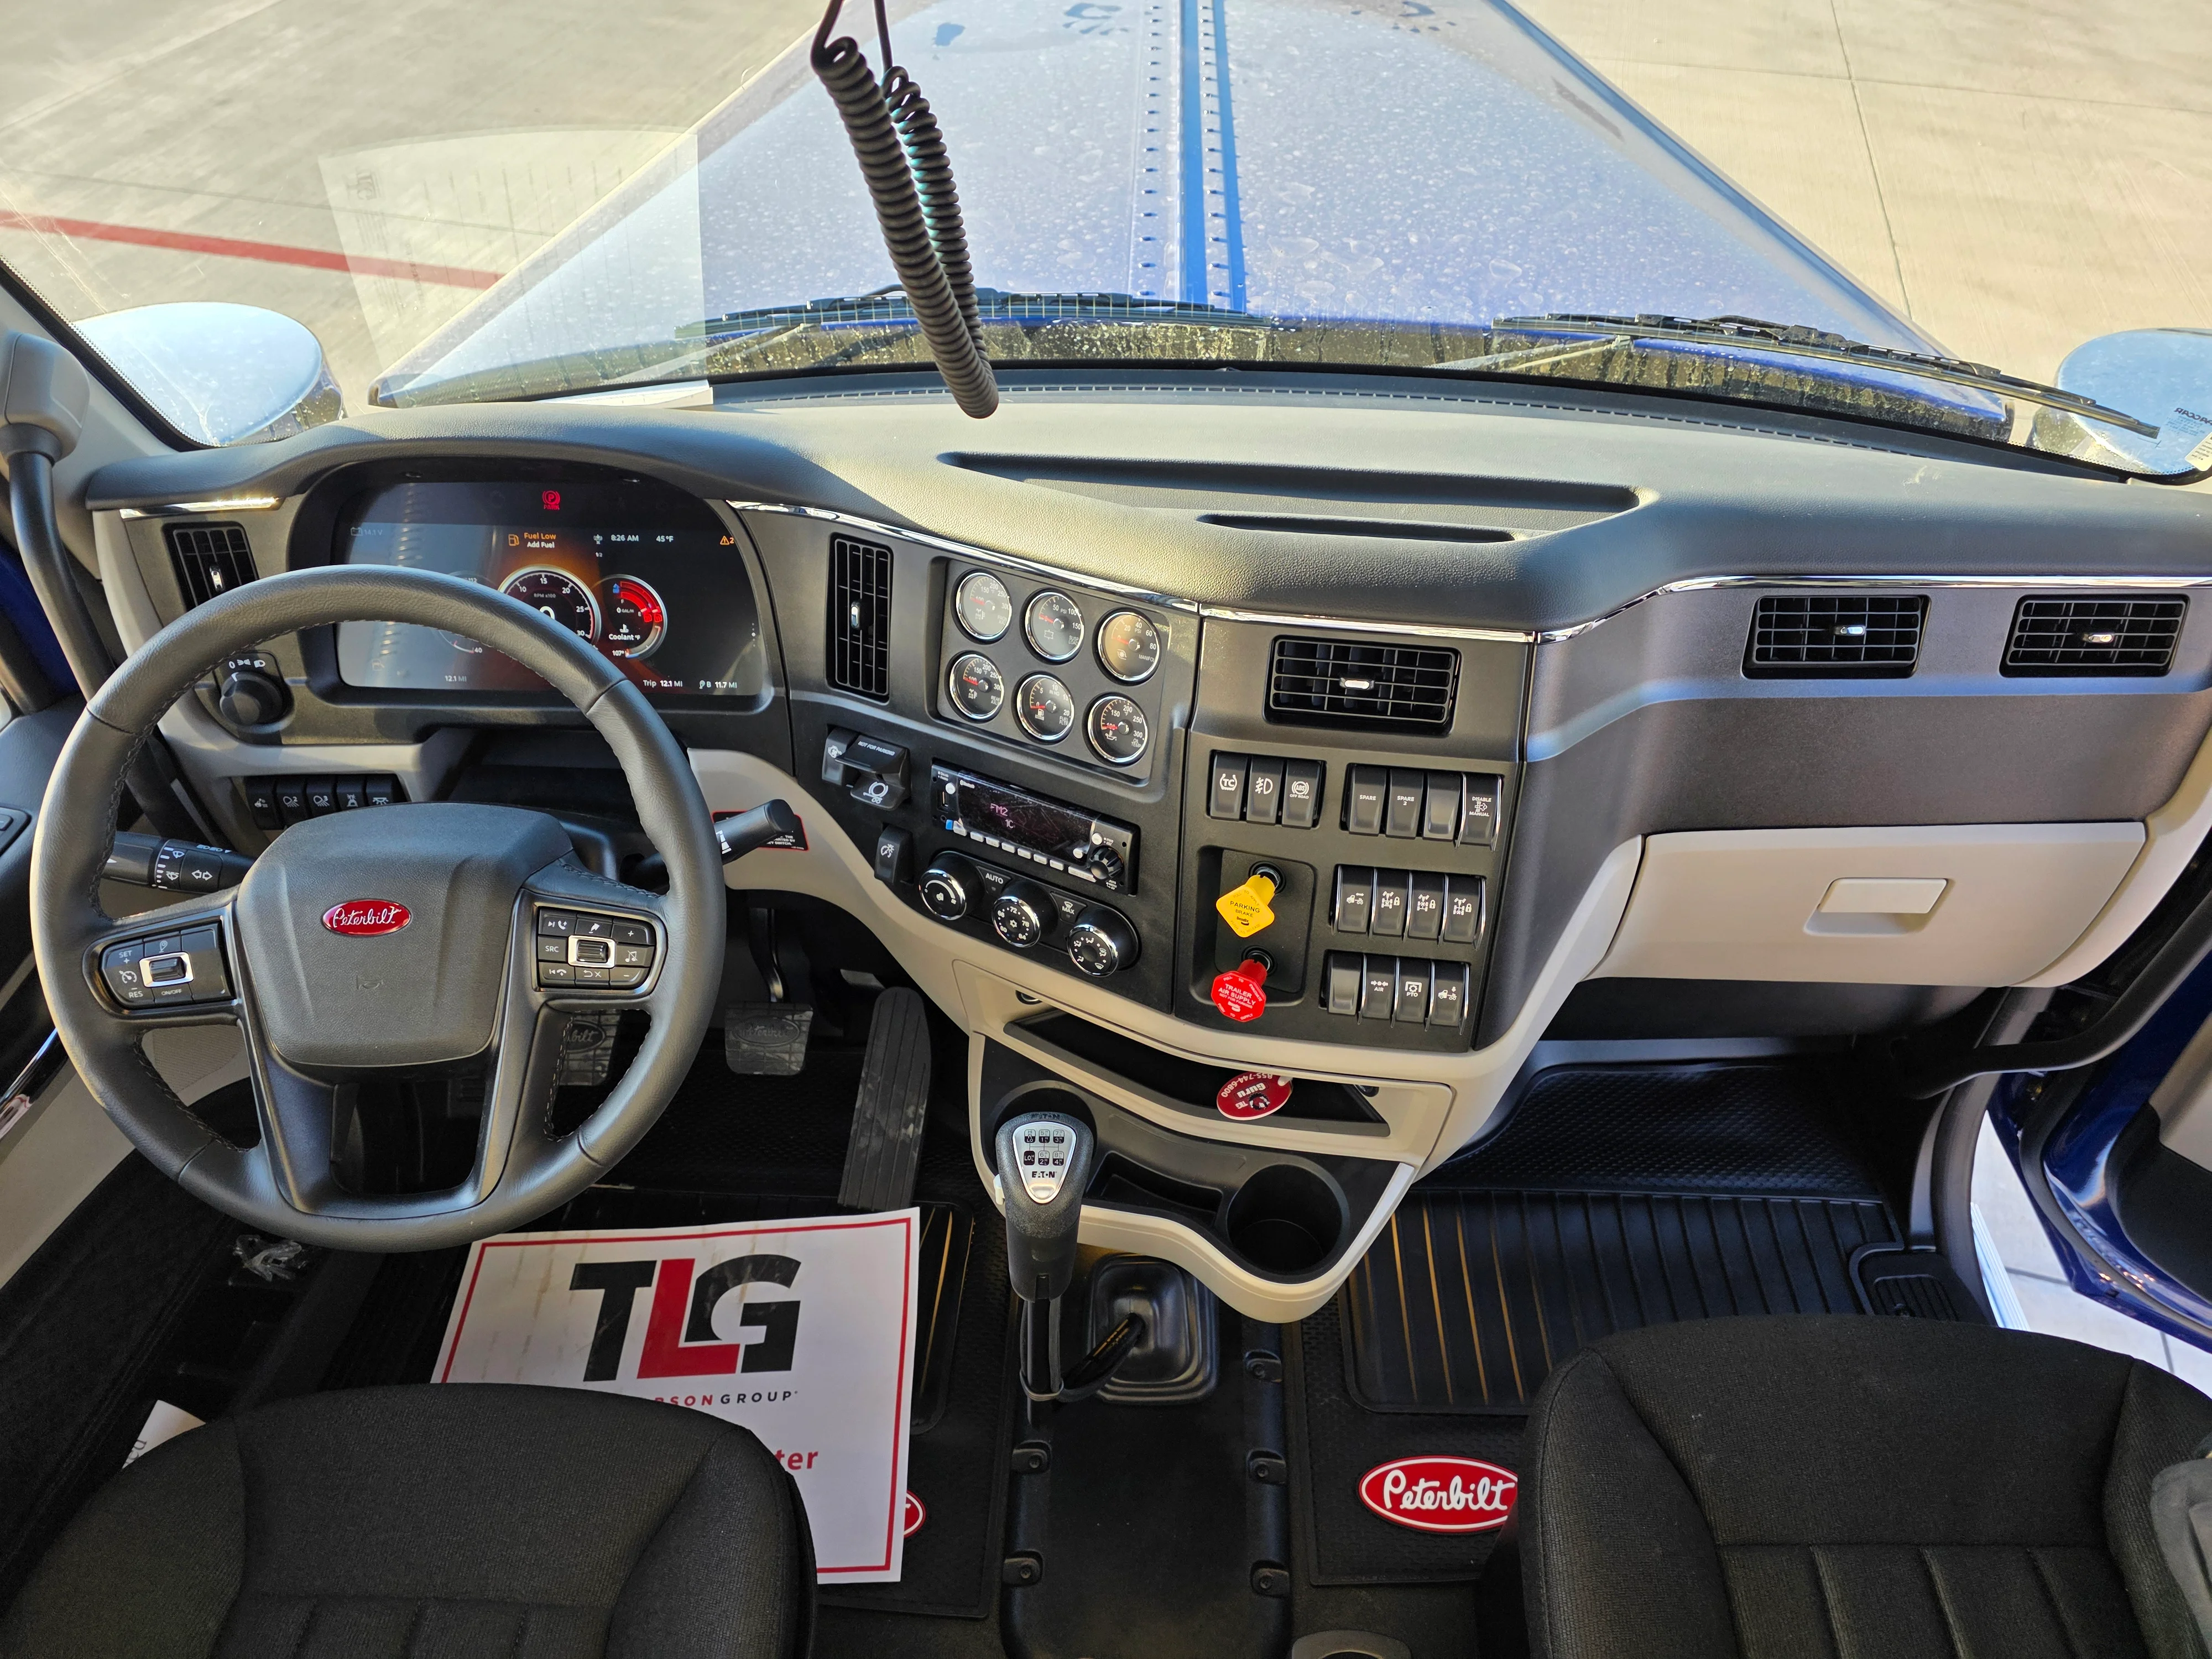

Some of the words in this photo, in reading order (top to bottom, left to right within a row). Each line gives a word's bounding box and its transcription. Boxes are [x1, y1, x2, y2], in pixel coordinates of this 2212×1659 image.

[643, 680, 657, 688] Trip
[1123, 705, 1133, 713] 200
[1133, 730, 1143, 738] 300
[875, 746, 895, 756] PARKING
[1223, 778, 1235, 787] TC
[985, 873, 1004, 884] AUTO
[1062, 906, 1074, 915] MAX
[1230, 900, 1260, 913] PARKING
[332, 905, 402, 928] Peterbilt
[1235, 909, 1254, 918] BRAKE
[118, 950, 132, 958] SET
[128, 990, 143, 999] RES
[1218, 987, 1230, 995] AIR
[1230, 992, 1256, 1005] SUPPLY
[1225, 983, 1253, 999] TRAILER
[1220, 1072, 1273, 1098] 855-744-6800
[1237, 1082, 1266, 1098] Guru
[569, 1254, 801, 1381] TLG
[721, 1391, 791, 1405] GROUP
[1383, 1469, 1515, 1511] Peterbilt
